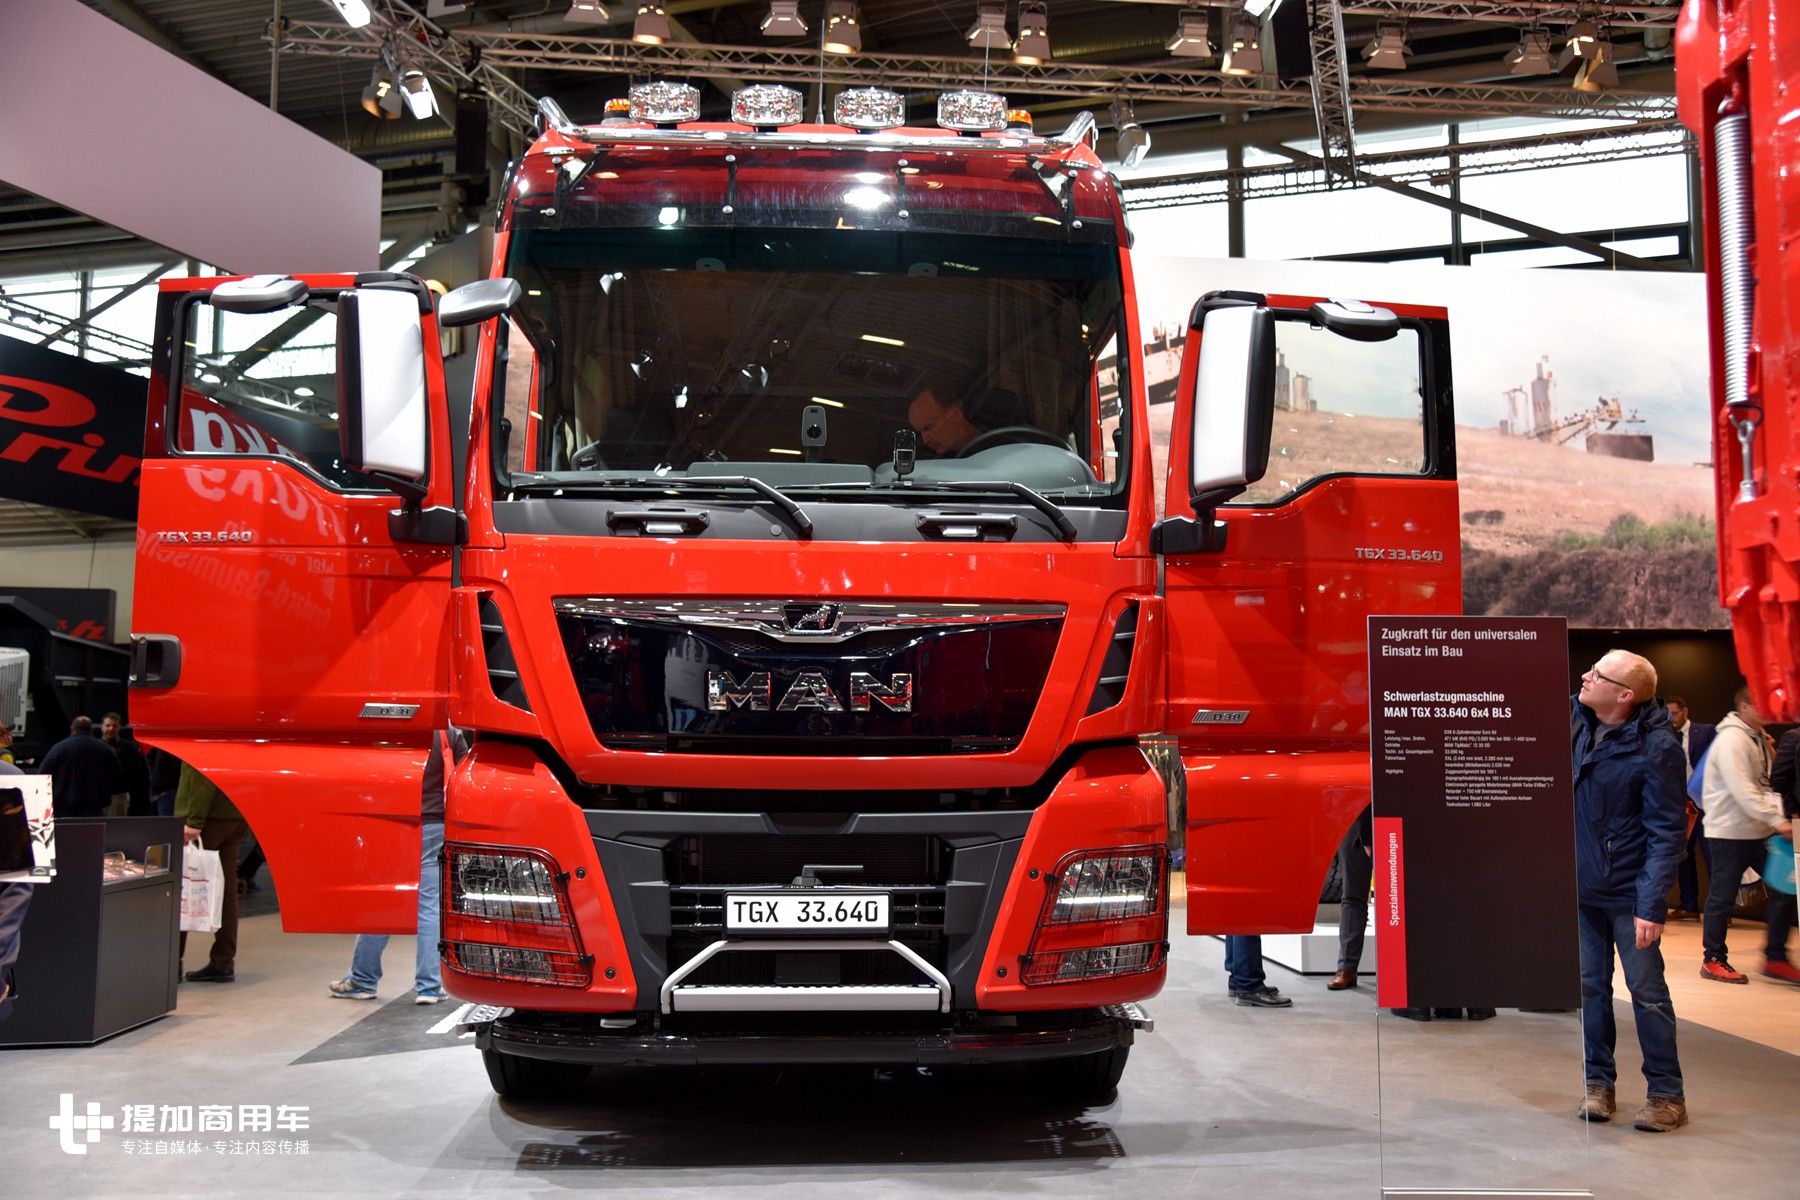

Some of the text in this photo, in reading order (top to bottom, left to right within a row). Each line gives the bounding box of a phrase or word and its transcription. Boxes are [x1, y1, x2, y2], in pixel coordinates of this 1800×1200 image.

[157, 531, 252, 543] TGX 33.640
[1355, 548, 1443, 562] TGX 33.640
[1382, 628, 1537, 642] Zugkraft für den universalen
[1382, 645, 1463, 657] Einsatz im Bau
[708, 671, 912, 712] MAN
[1384, 690, 1505, 704] Schwerlastzugmaschine
[380, 706, 410, 716] D38
[1213, 712, 1240, 720] D38
[1384, 707, 1512, 718] MAN TGX 33.640 6x4 BLS
[1388, 832, 1400, 926] Spezialanwendungen
[734, 900, 878, 923] TGX 33.640
